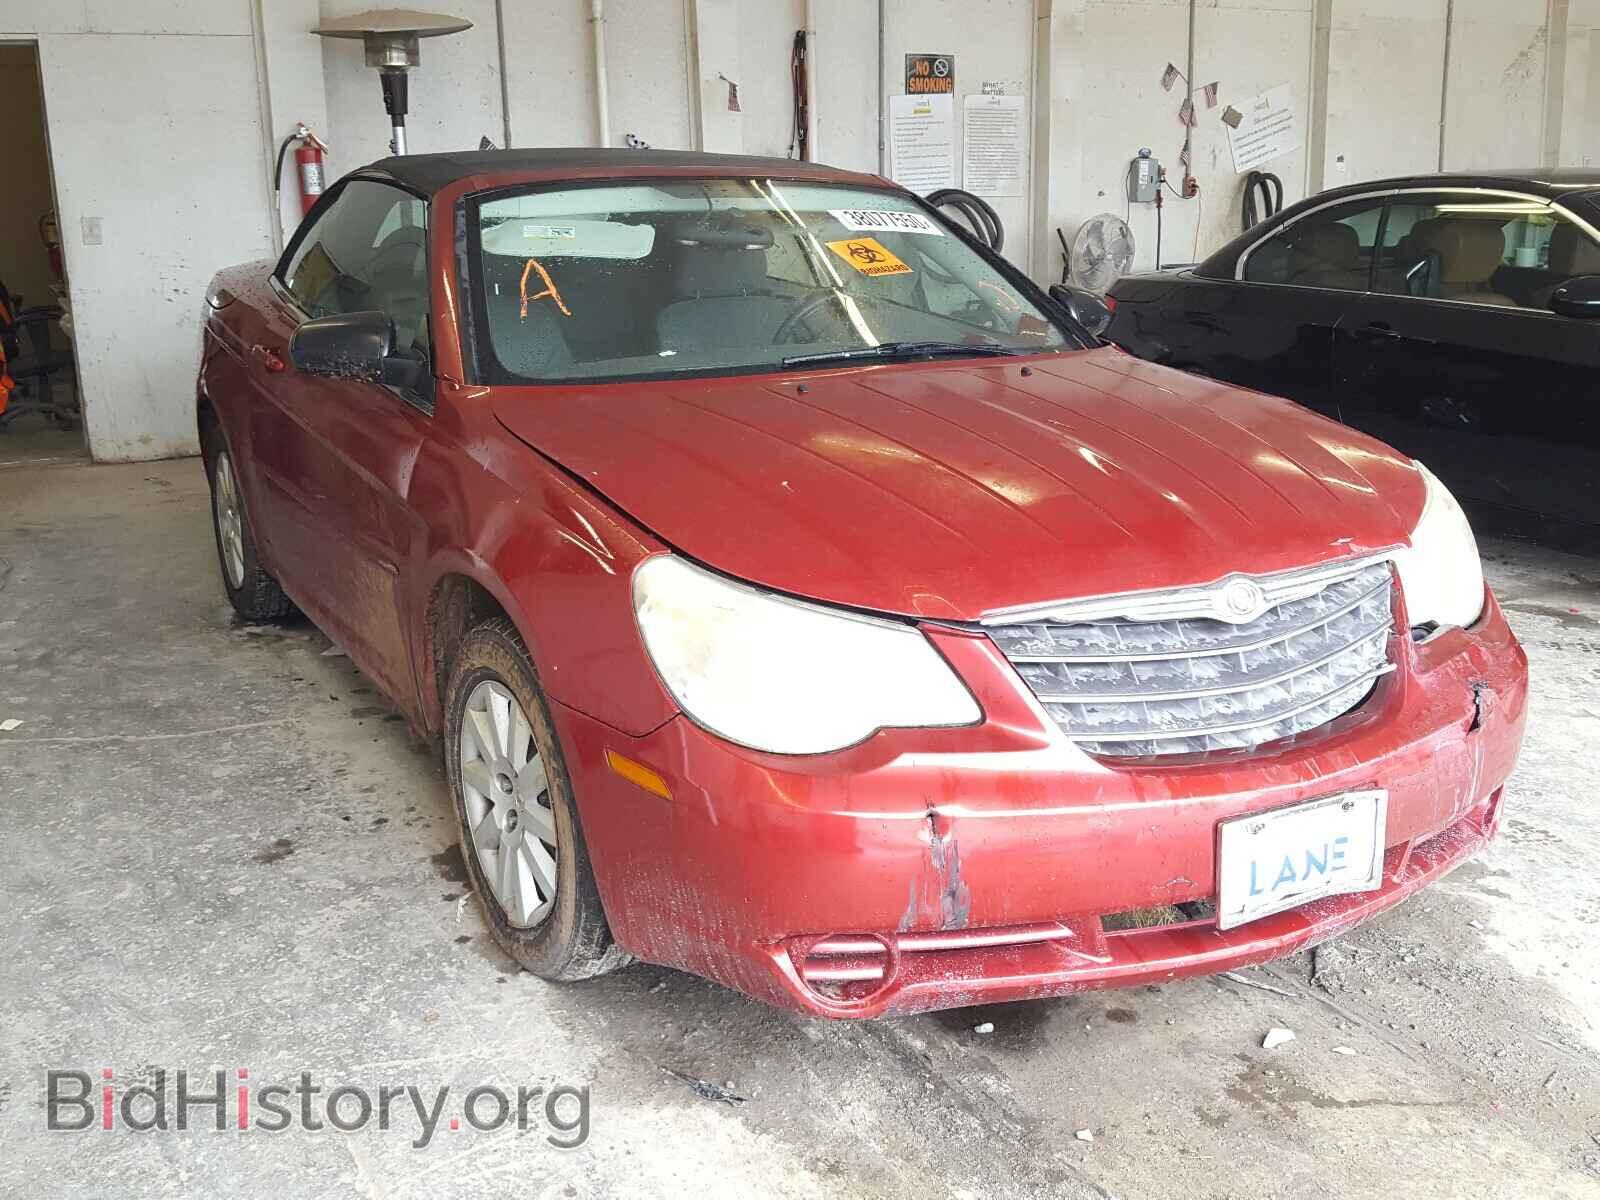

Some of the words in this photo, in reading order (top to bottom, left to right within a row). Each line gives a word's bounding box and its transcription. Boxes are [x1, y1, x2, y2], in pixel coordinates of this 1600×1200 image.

[915, 60, 929, 76] NO
[909, 77, 952, 92] SMOKING
[860, 264, 910, 275] BIOHAZARD
[519, 258, 573, 323] A
[1249, 836, 1349, 897] LANE
